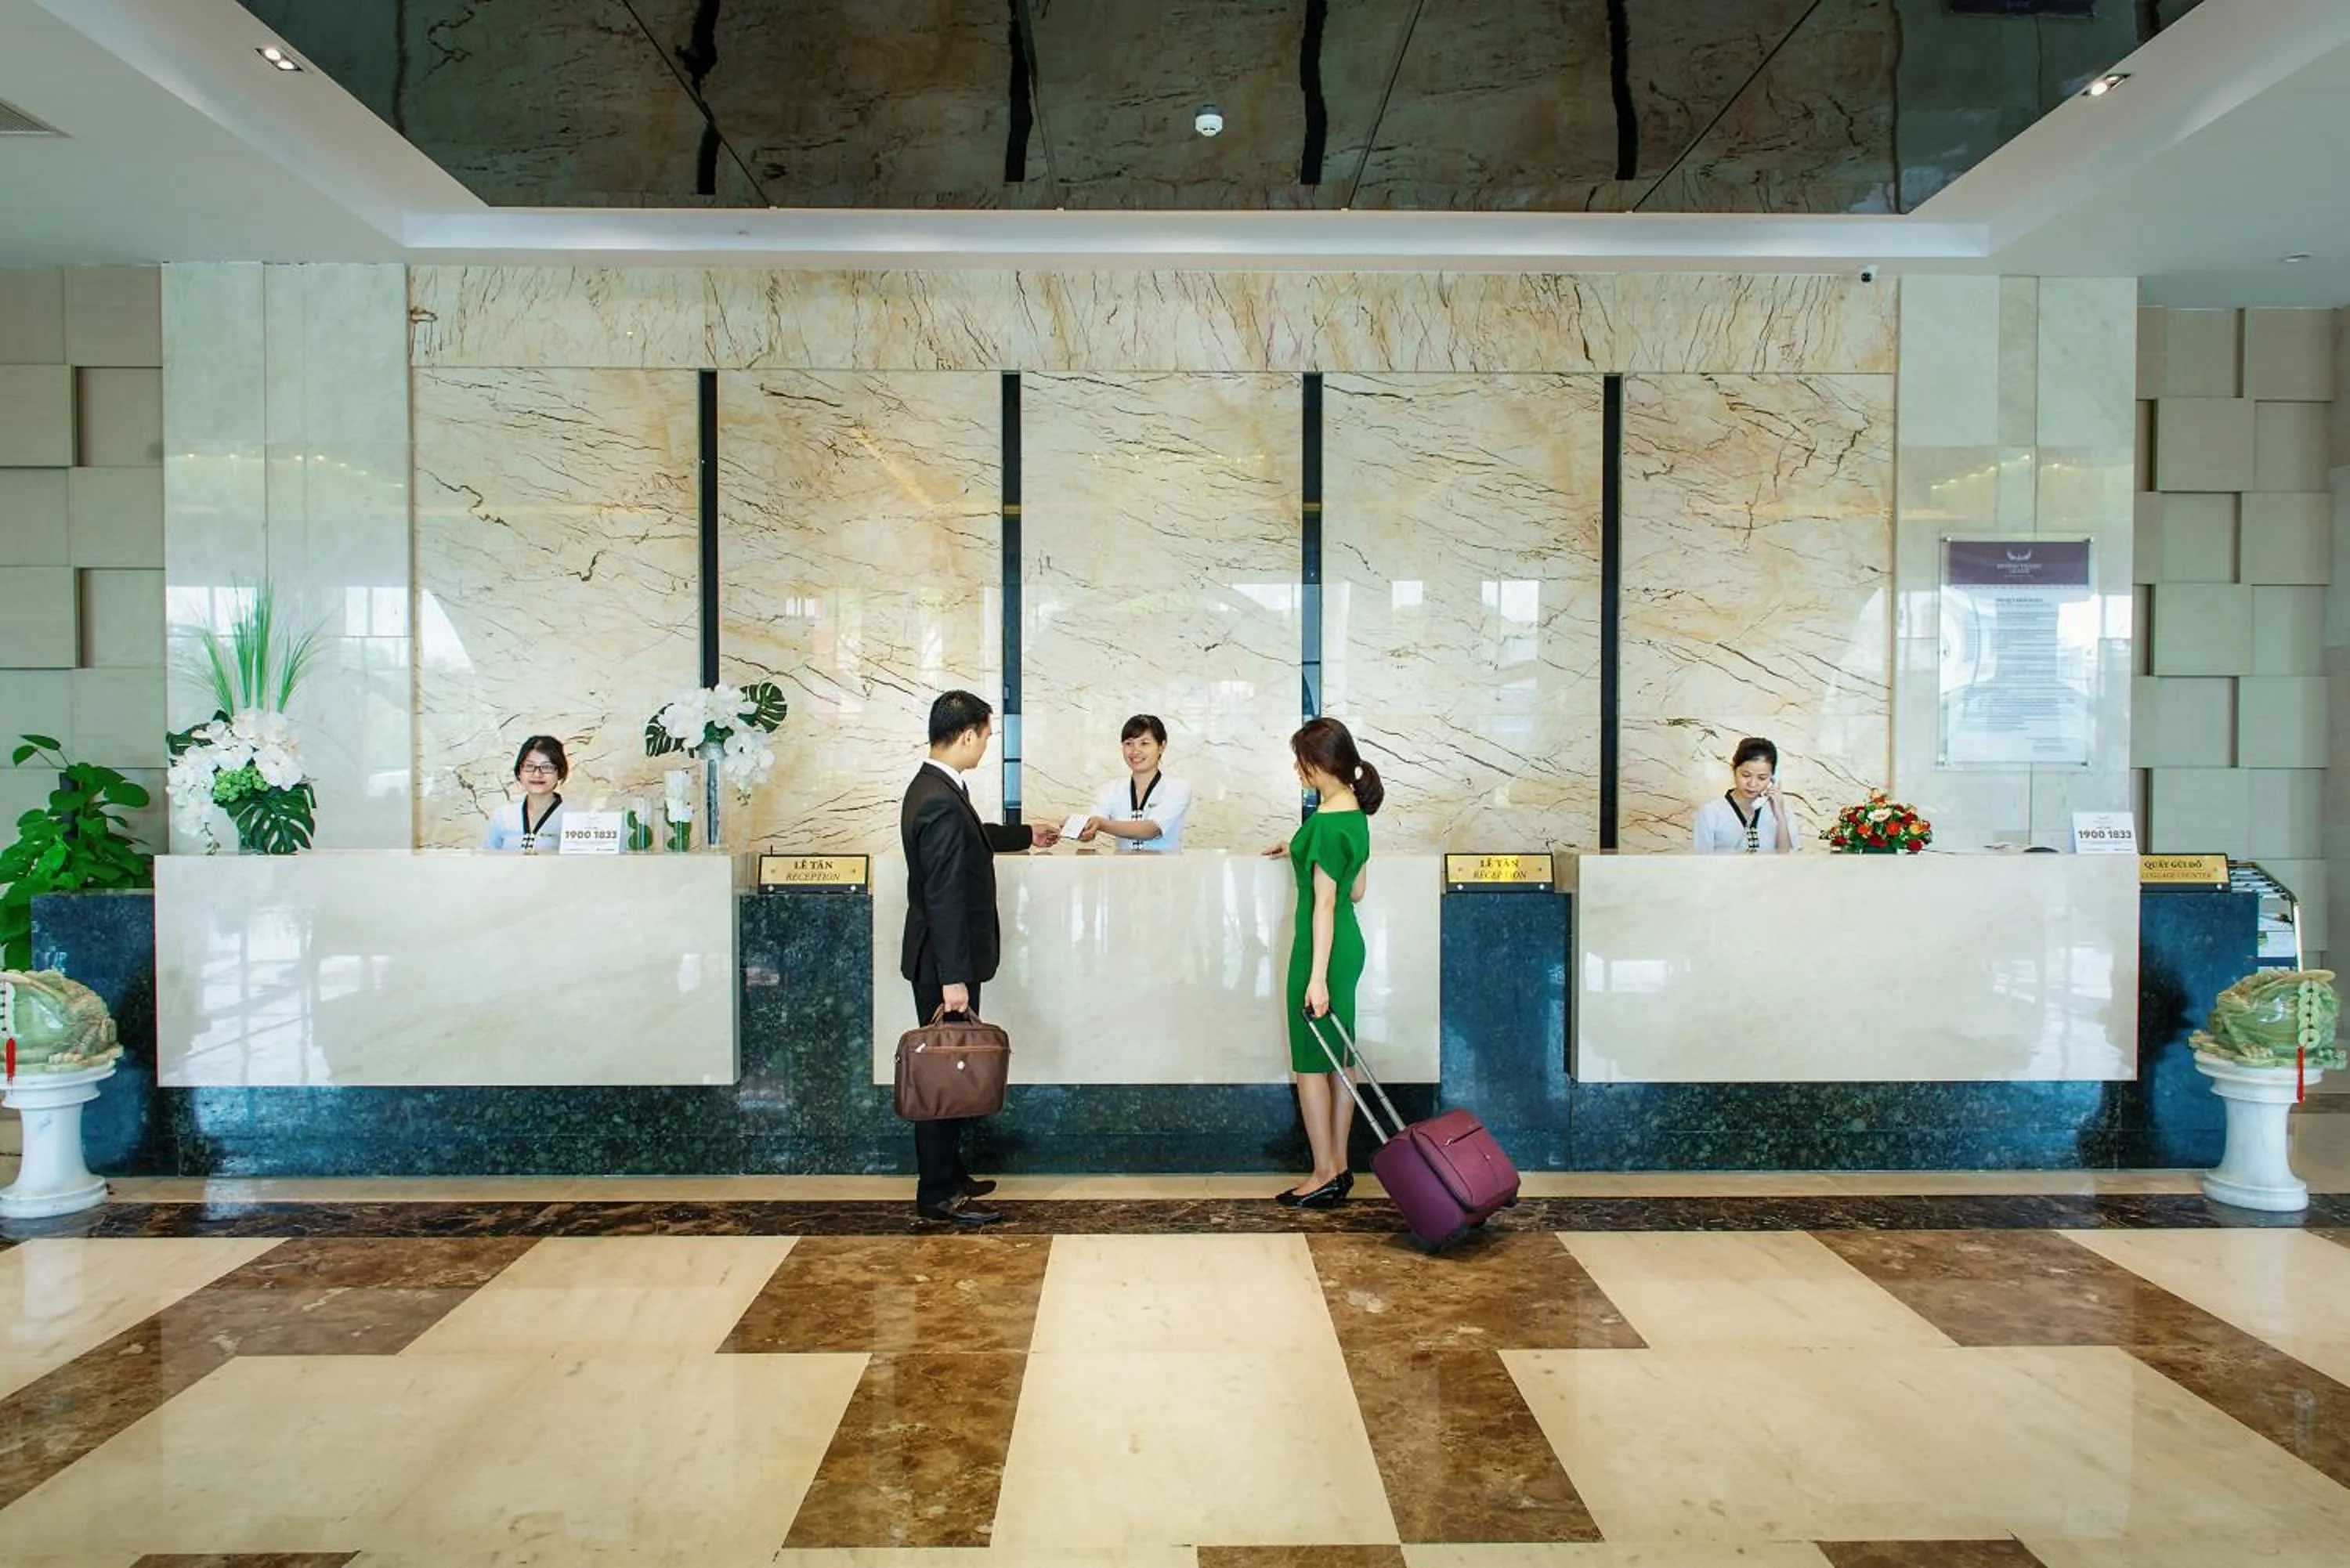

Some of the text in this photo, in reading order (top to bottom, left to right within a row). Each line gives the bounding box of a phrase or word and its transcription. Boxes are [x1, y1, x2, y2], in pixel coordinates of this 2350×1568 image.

[565, 830, 617, 839] 1900 1833
[2077, 829, 2131, 839] 1900 1833
[786, 872, 841, 881] RECEPTION
[1473, 870, 1528, 880] RECEPON
